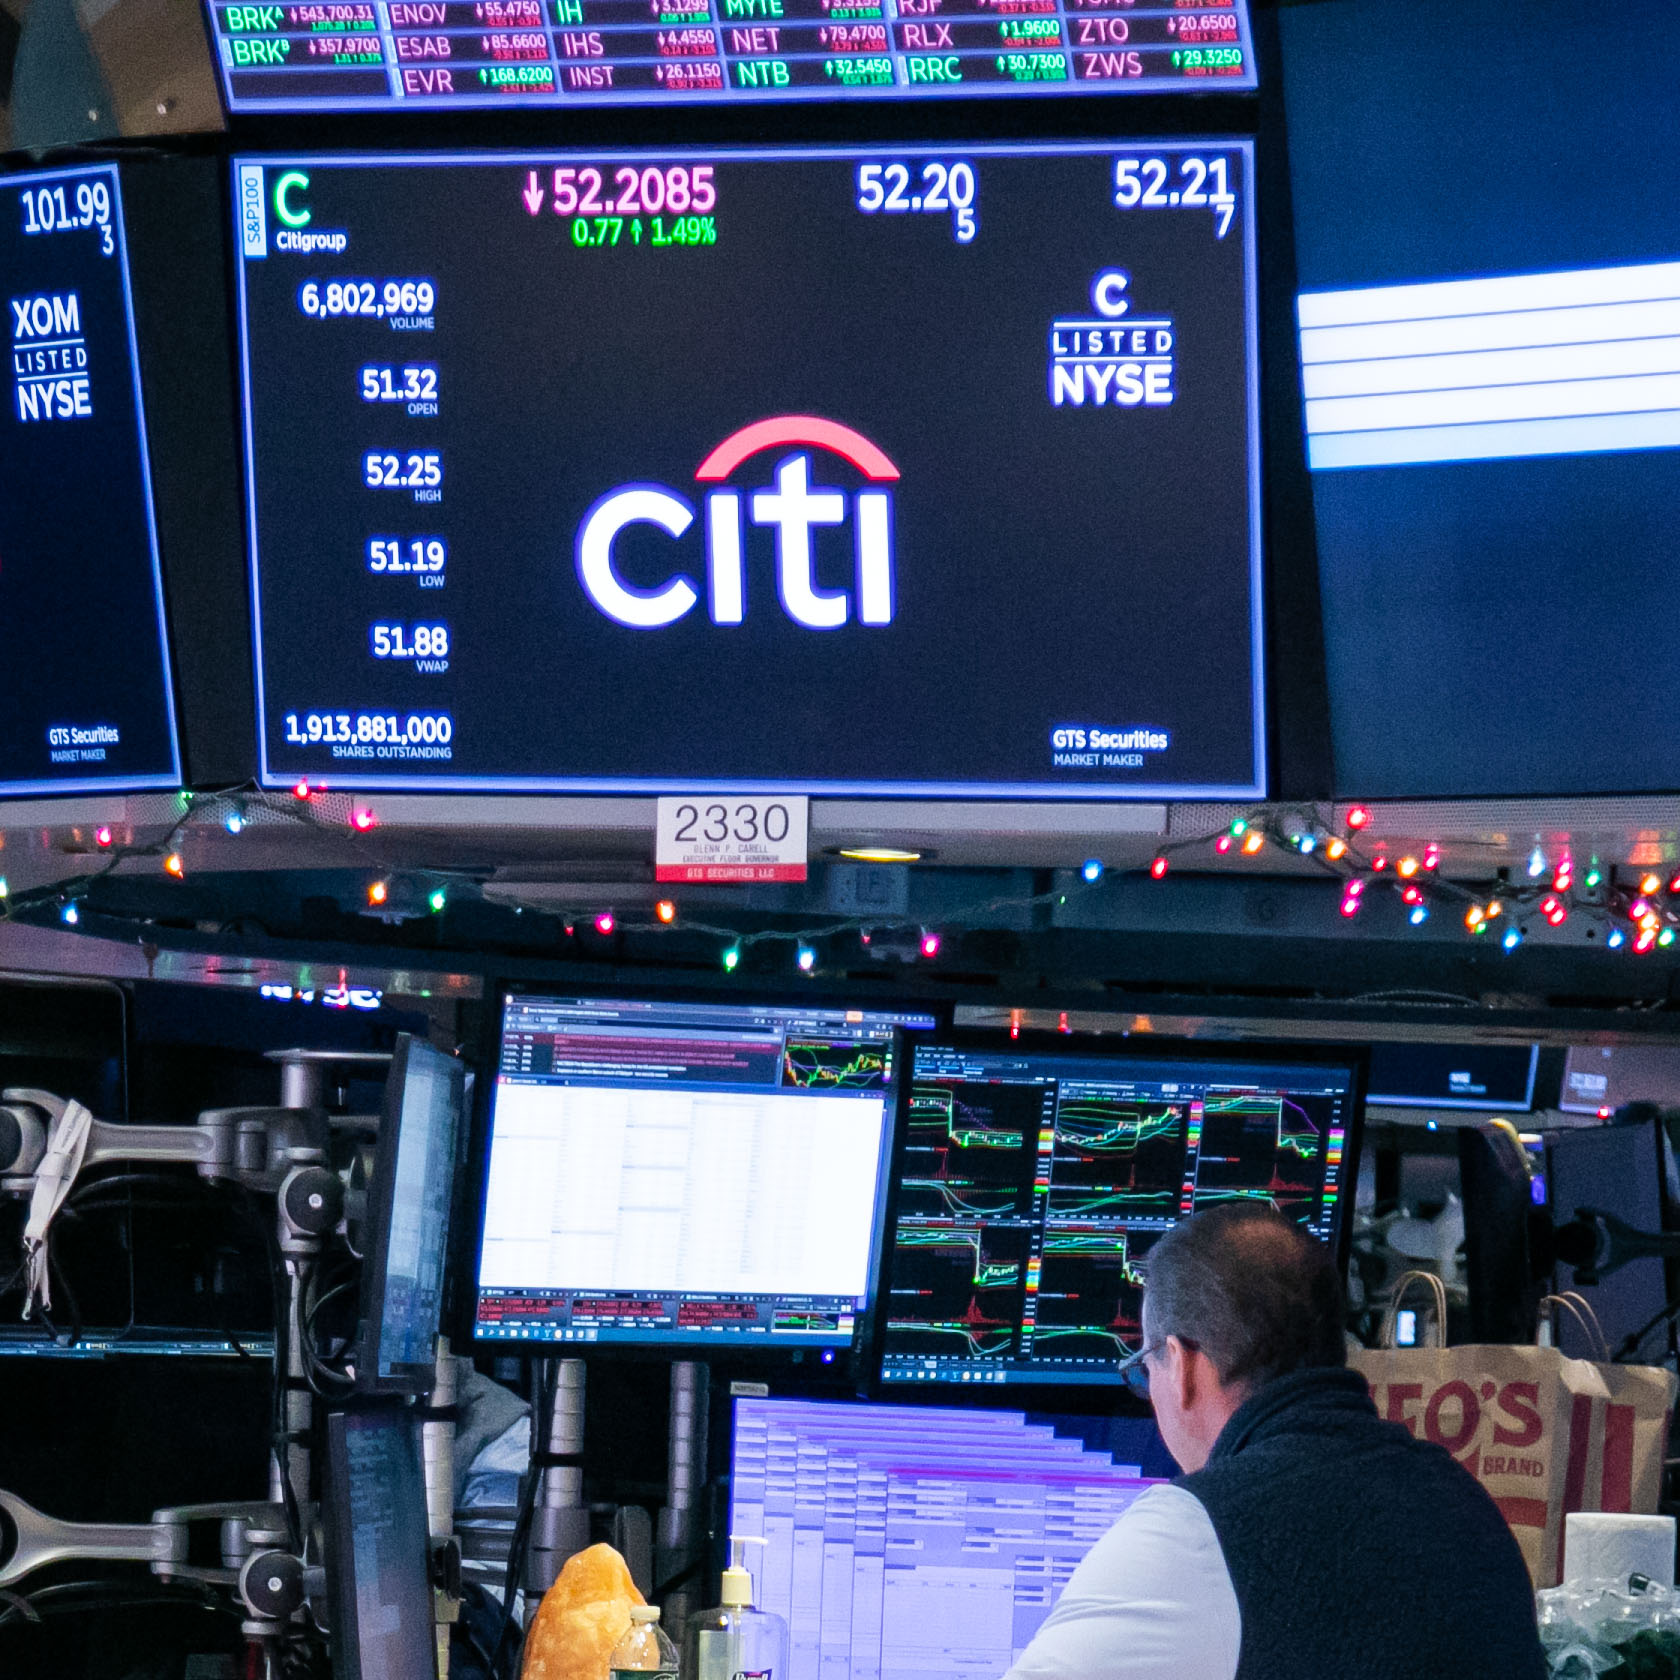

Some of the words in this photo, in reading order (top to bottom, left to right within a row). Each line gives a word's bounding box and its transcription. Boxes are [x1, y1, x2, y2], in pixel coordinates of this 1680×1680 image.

[392, 4, 446, 25] ENOV
[564, 32, 604, 56] IHS
[668, 29, 714, 44] 4.4550
[732, 28, 780, 51] NET
[829, 25, 885, 41] 79.4700
[905, 24, 954, 48] RLX
[1012, 20, 1060, 36] 1.9600
[1079, 18, 1129, 43] ZTO
[1178, 15, 1237, 31] 20.6500
[319, 37, 380, 53] 357.9700
[398, 36, 451, 57] ESAB
[492, 34, 546, 49] 85.6600
[571, 66, 613, 86] INST
[666, 63, 720, 79] 26.1150
[738, 62, 790, 86] NTB
[835, 59, 892, 74] 32.5450
[910, 57, 963, 82] RRC
[1007, 54, 1066, 70] 30.7300
[1083, 52, 1143, 76] ZWS
[1184, 49, 1243, 65] 29.3250
[404, 69, 453, 93] EVR
[492, 67, 552, 83] 168.6200
[553, 167, 716, 213] 52.2085
[858, 163, 975, 209] 52.20
[1116, 158, 1234, 206] 52.21
[22, 182, 110, 233] 101.99
[245, 177, 261, 243] S&P100
[275, 172, 311, 225] C
[1216, 204, 1234, 238] 7
[573, 218, 622, 245] 0.77
[651, 216, 716, 245] 1.49%
[957, 208, 975, 241] 5
[101, 224, 114, 254] 3
[276, 230, 347, 253] Citigroup
[302, 282, 434, 316] 6,802,969
[1094, 273, 1128, 316] C
[12, 294, 80, 338] XOM
[390, 317, 435, 329] VOLUME
[1052, 330, 1172, 353] LISTED
[14, 347, 87, 373] LISTED
[363, 369, 437, 399] 51.32
[1053, 363, 1173, 405] NYSE
[18, 379, 92, 421] NYSE
[407, 403, 438, 415] OPEN
[366, 455, 441, 486] 52.25
[415, 489, 442, 501] HIGH
[578, 455, 892, 628] citi
[370, 541, 444, 571] 51.19
[420, 575, 445, 587] LOW
[374, 626, 448, 656] 51.88
[416, 660, 449, 672] VWAP
[50, 728, 69, 744] GTS
[71, 726, 119, 744] Securities
[286, 715, 452, 745] 1,913,881,000
[1053, 729, 1086, 748] GTS
[1089, 729, 1168, 748] Securities
[51, 749, 79, 762] MARKET
[81, 748, 106, 760] MAKER
[332, 745, 374, 757] SHARES
[377, 746, 452, 759] OUTSTANDING
[1054, 753, 1100, 766] MARKET
[1103, 753, 1144, 766] MAKER
[674, 804, 789, 842] 2330
[707, 867, 754, 878] SECURITIES
[758, 867, 775, 878] LLC
[1484, 1456, 1544, 1478] BRAND
